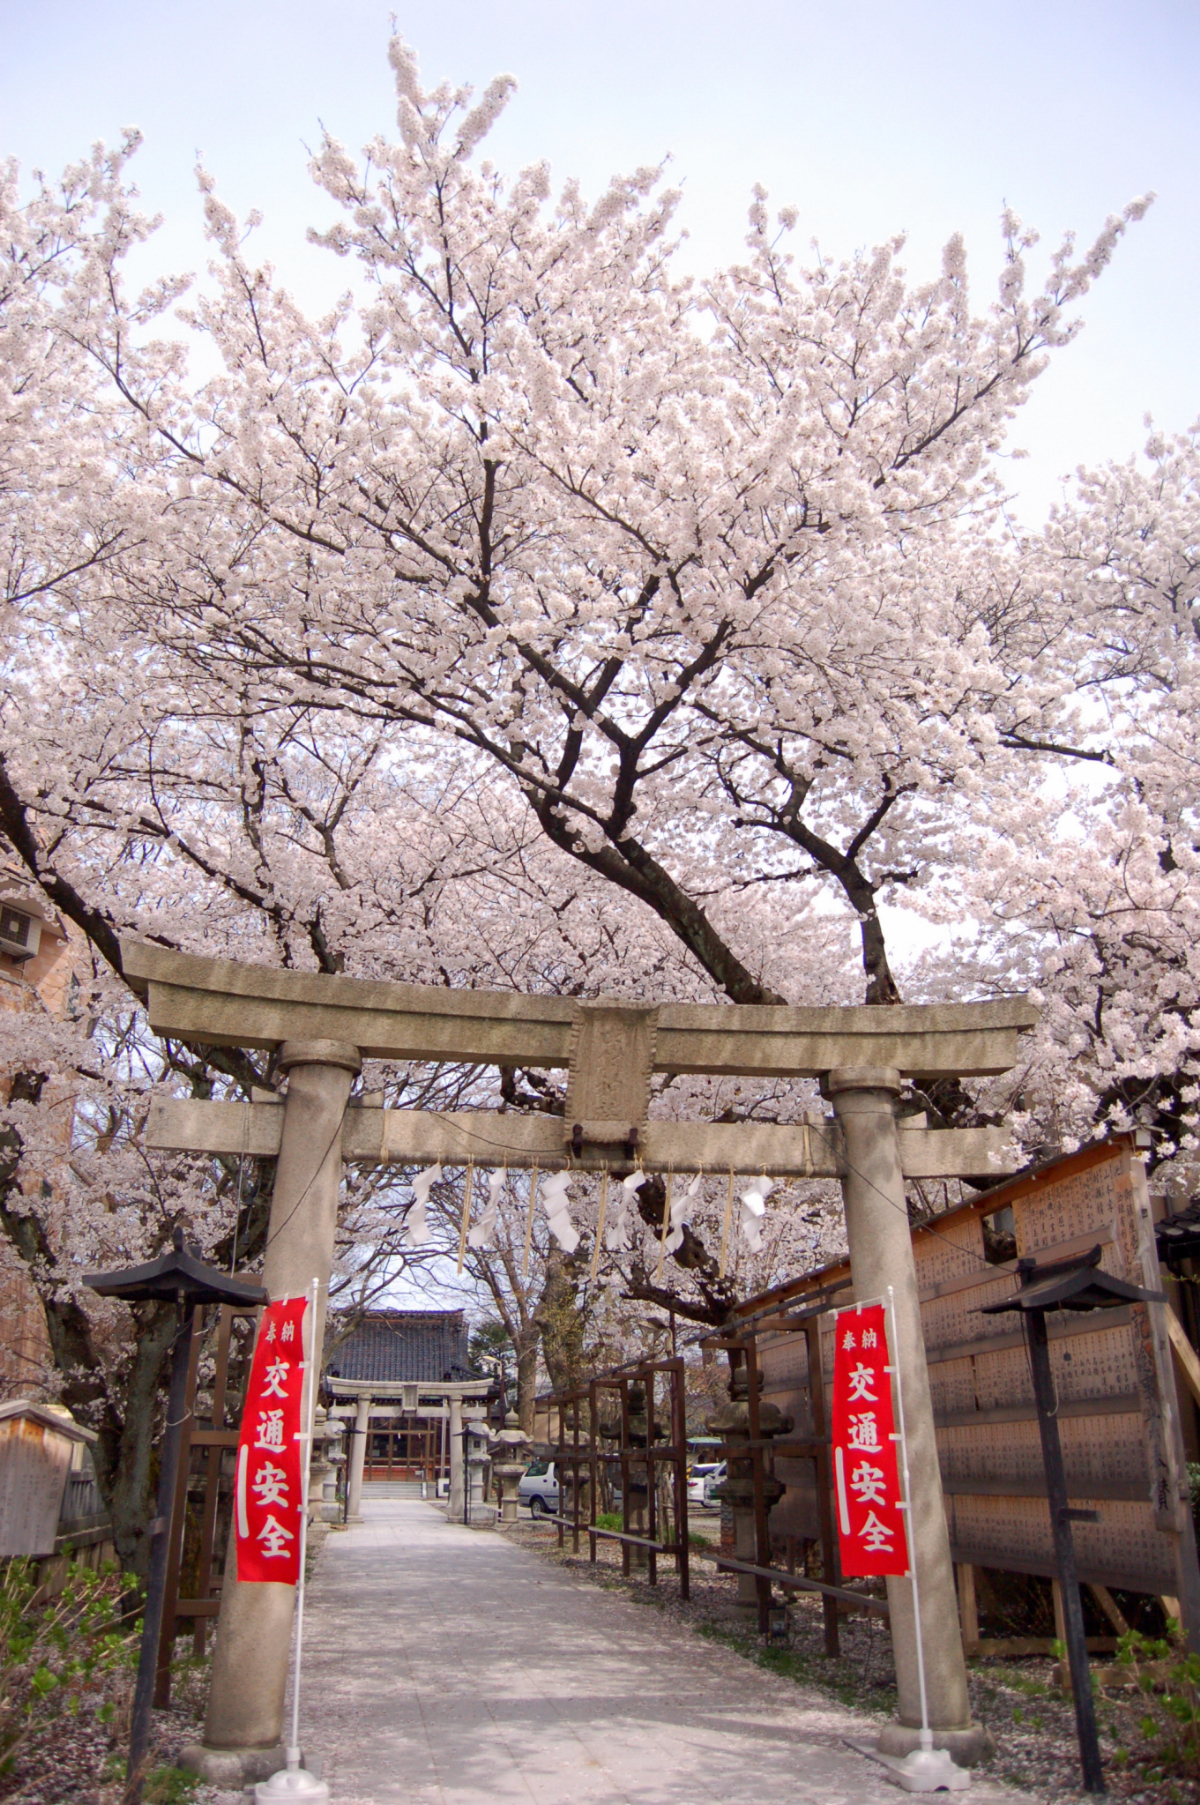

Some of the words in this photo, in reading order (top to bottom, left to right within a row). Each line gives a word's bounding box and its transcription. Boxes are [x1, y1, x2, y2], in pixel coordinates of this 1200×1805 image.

[265, 1320, 295, 1343] 奉納
[842, 1328, 877, 1351] 奉納
[252, 1356, 295, 1558] 交通安全
[847, 1362, 894, 1552] 交通安全
